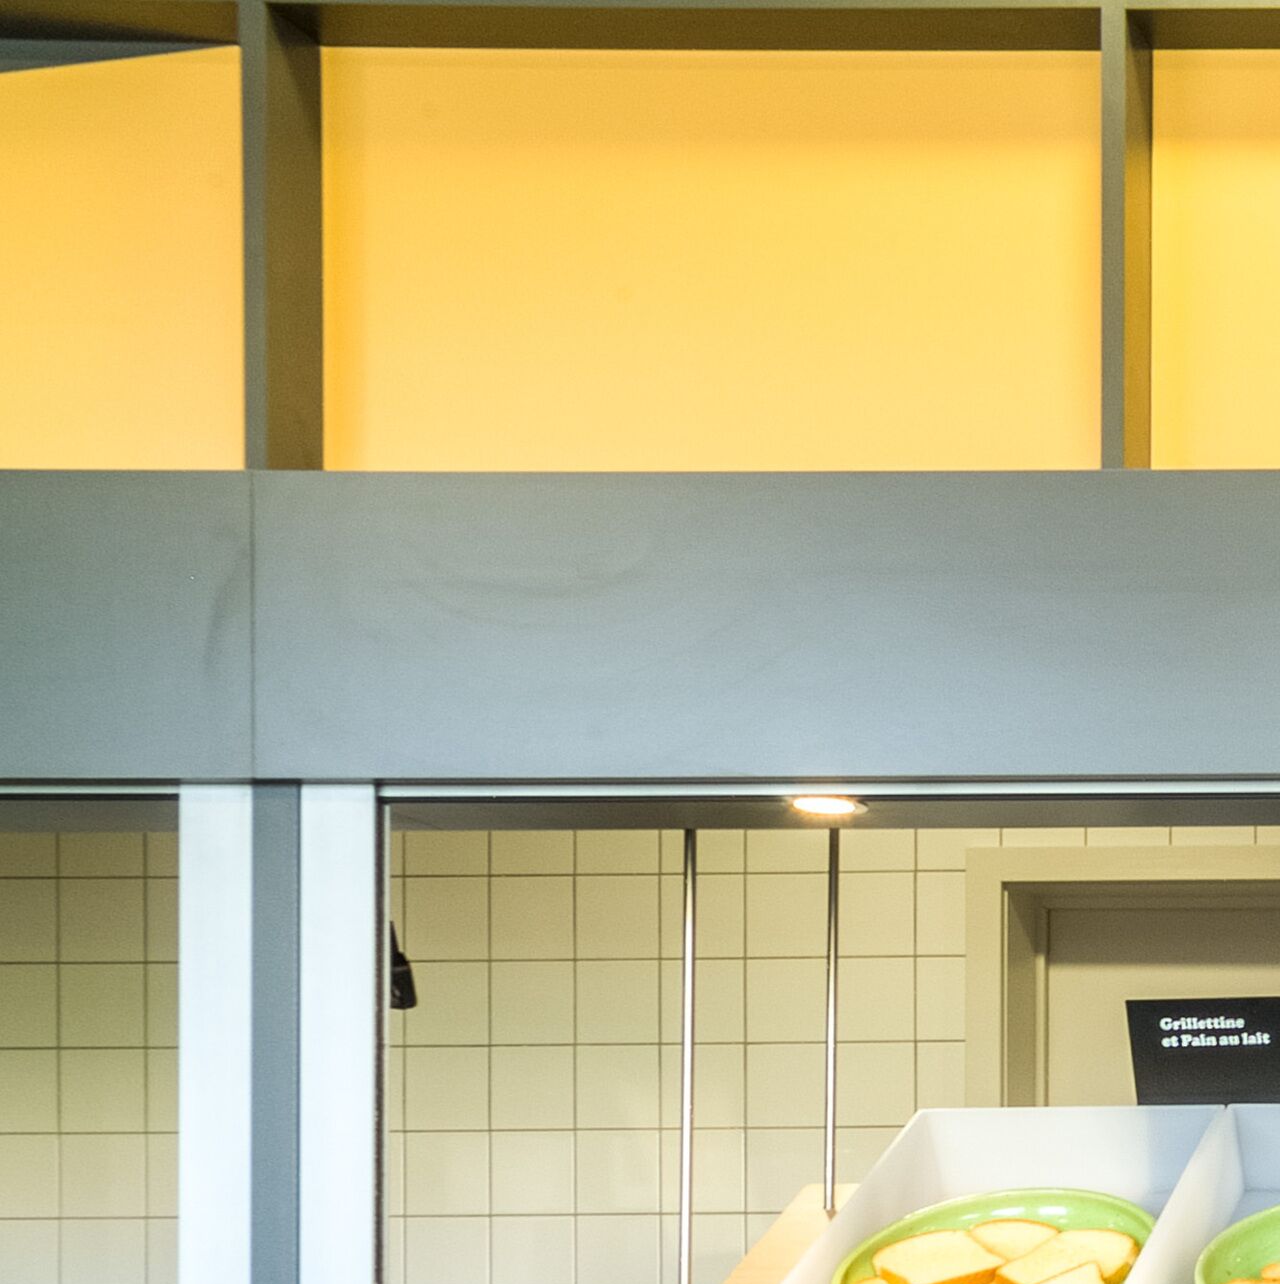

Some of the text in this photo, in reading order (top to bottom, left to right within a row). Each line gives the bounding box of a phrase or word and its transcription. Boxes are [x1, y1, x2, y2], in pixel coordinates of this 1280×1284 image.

[1159, 1016, 1245, 1031] Grillettine
[1161, 1032, 1271, 1047] et Pain au lait
